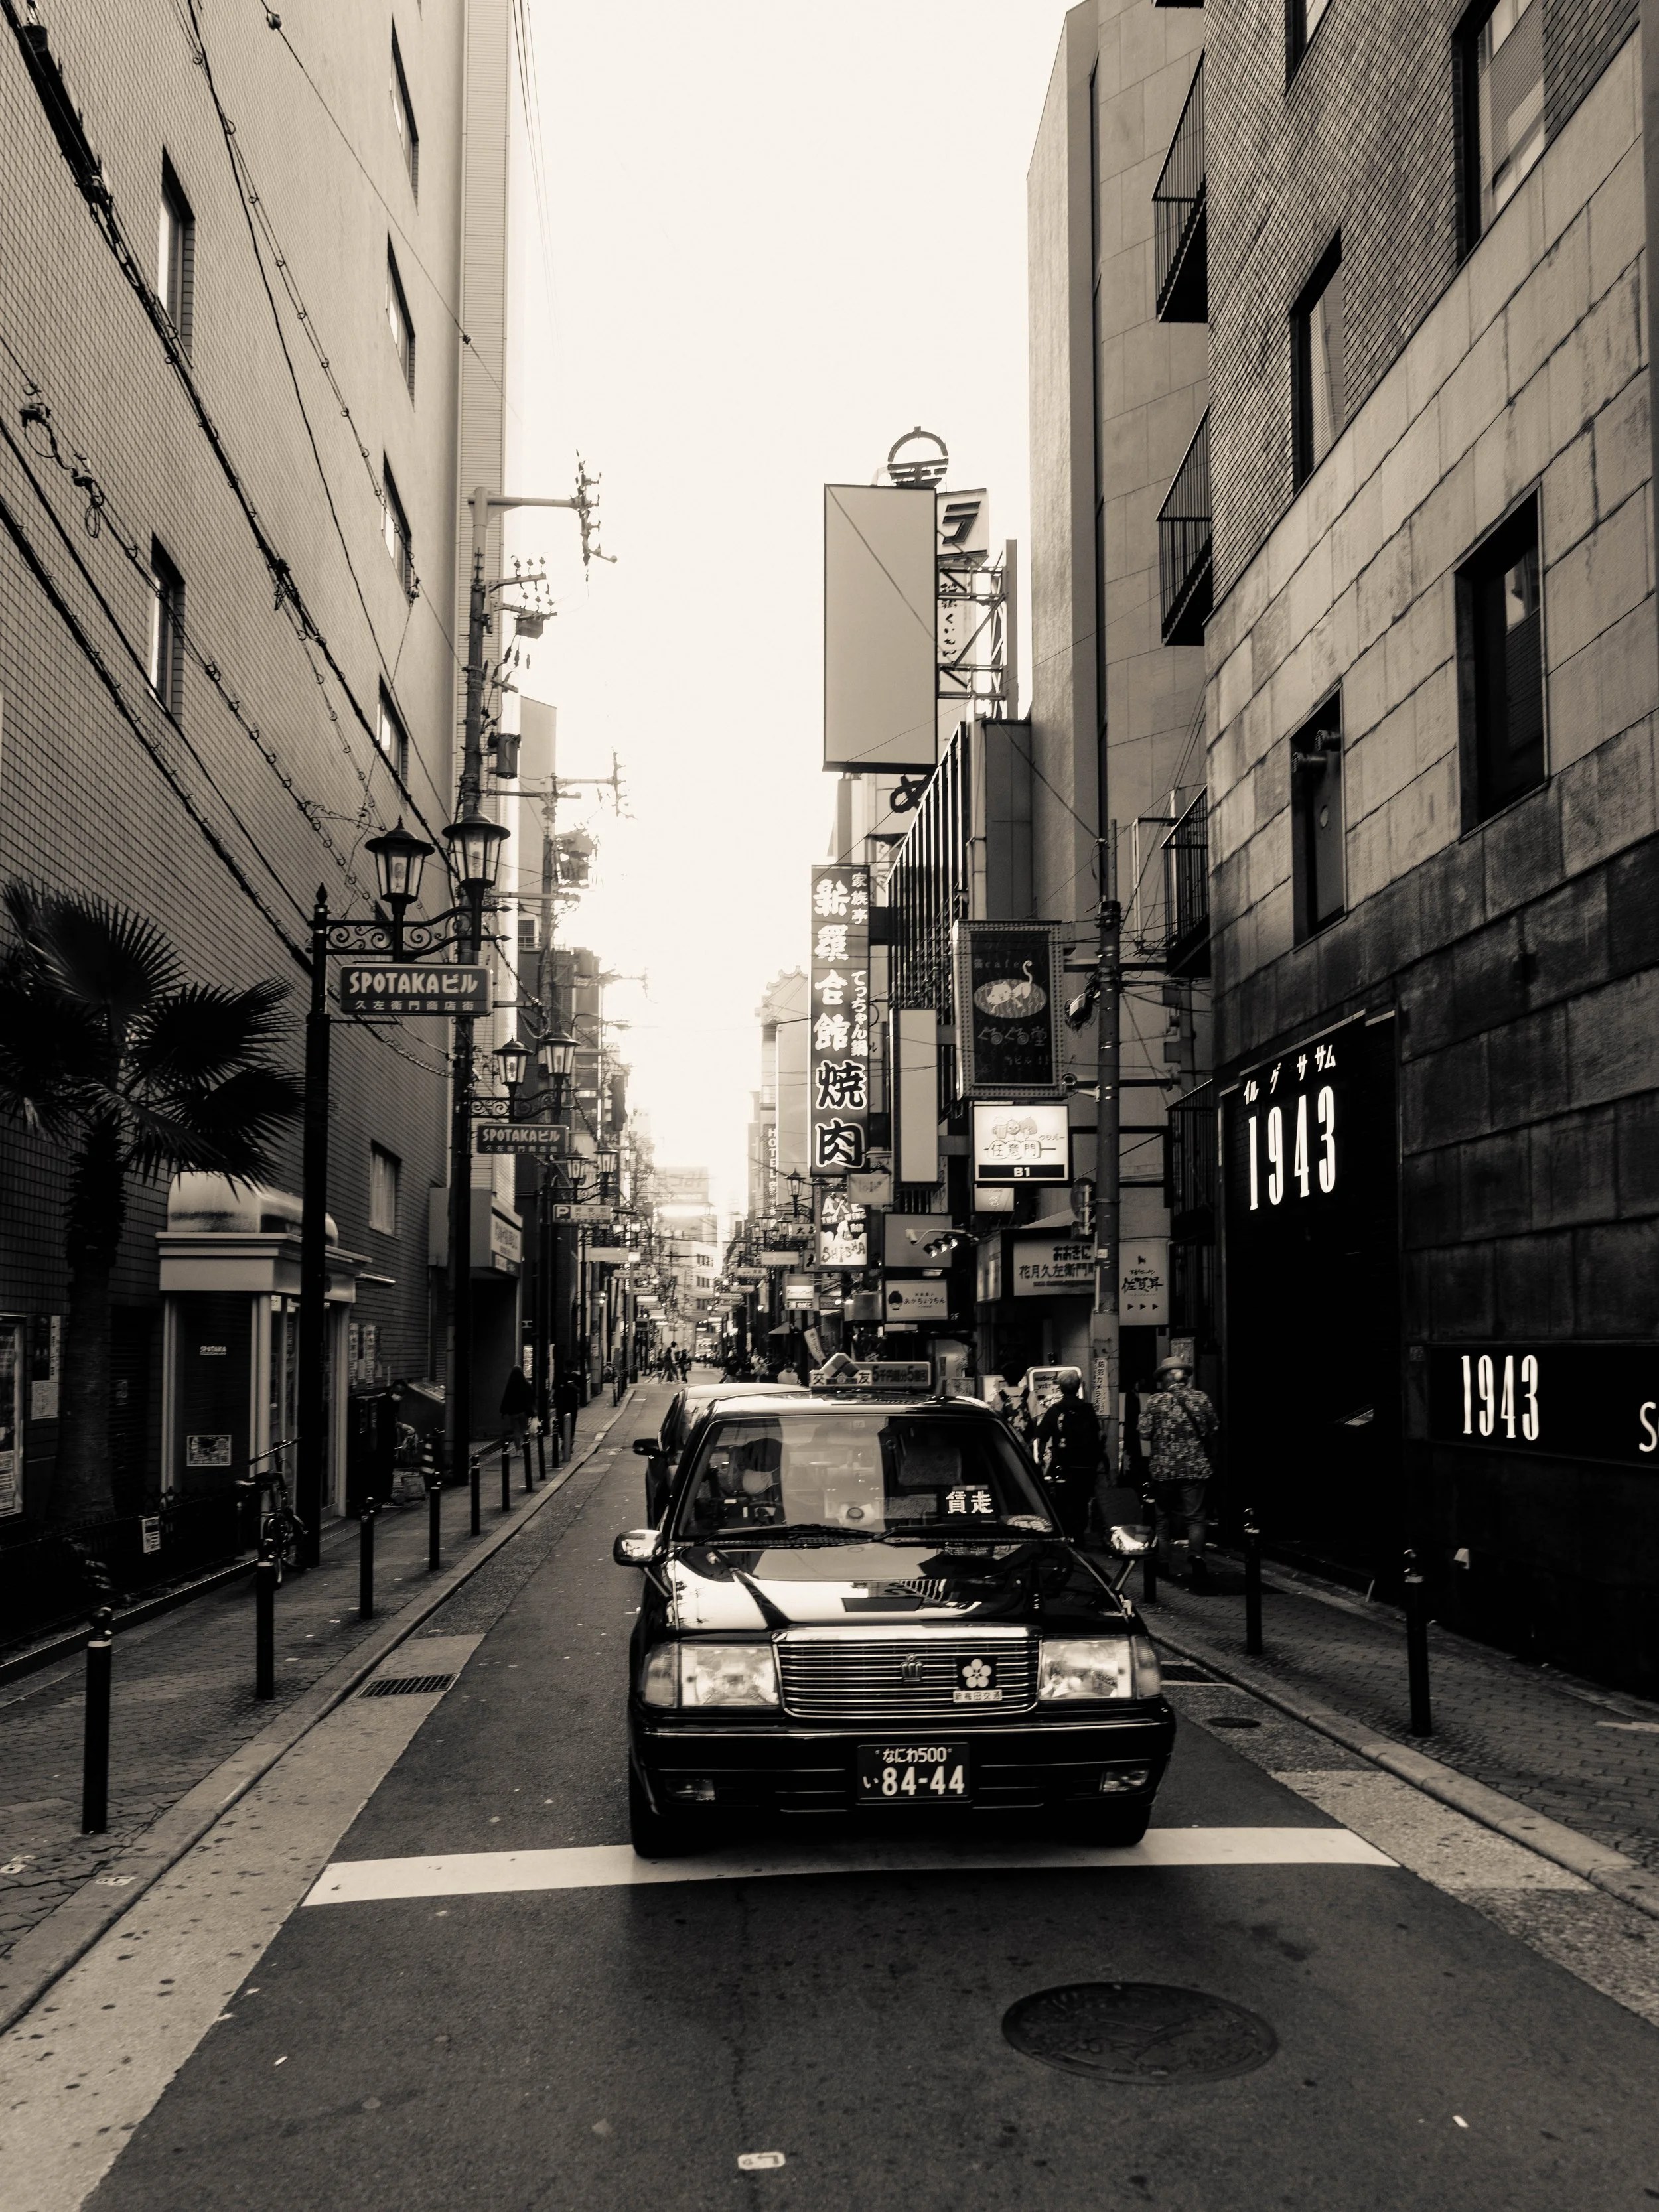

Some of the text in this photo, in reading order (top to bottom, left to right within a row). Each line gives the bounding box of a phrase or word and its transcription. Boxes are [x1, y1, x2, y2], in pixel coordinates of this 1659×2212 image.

[349, 971, 478, 994] SPOTAKAビル
[355, 1001, 474, 1011] 久左衛門商店街
[851, 970, 869, 1057] てっちゃん鍋
[1297, 1054, 1308, 1081] サ
[816, 1060, 867, 1168] 焼肉
[482, 1128, 561, 1142] SPOTAKAビル
[768, 1128, 778, 1179] HOTEL
[991, 1143, 1036, 1157] 任意門
[1248, 1085, 1336, 1211] 1943
[1013, 1166, 1030, 1178] B1
[556, 1206, 570, 1218] P
[822, 1192, 866, 1215] AXE
[1053, 1245, 1092, 1261] おおきに
[813, 1372, 871, 1385] 交 友
[1461, 1355, 1659, 1452] 1943 S
[946, 1490, 994, 1514] 賃走
[955, 1692, 1002, 1701] 新梅田交通
[863, 1765, 965, 1796] い 84-44
